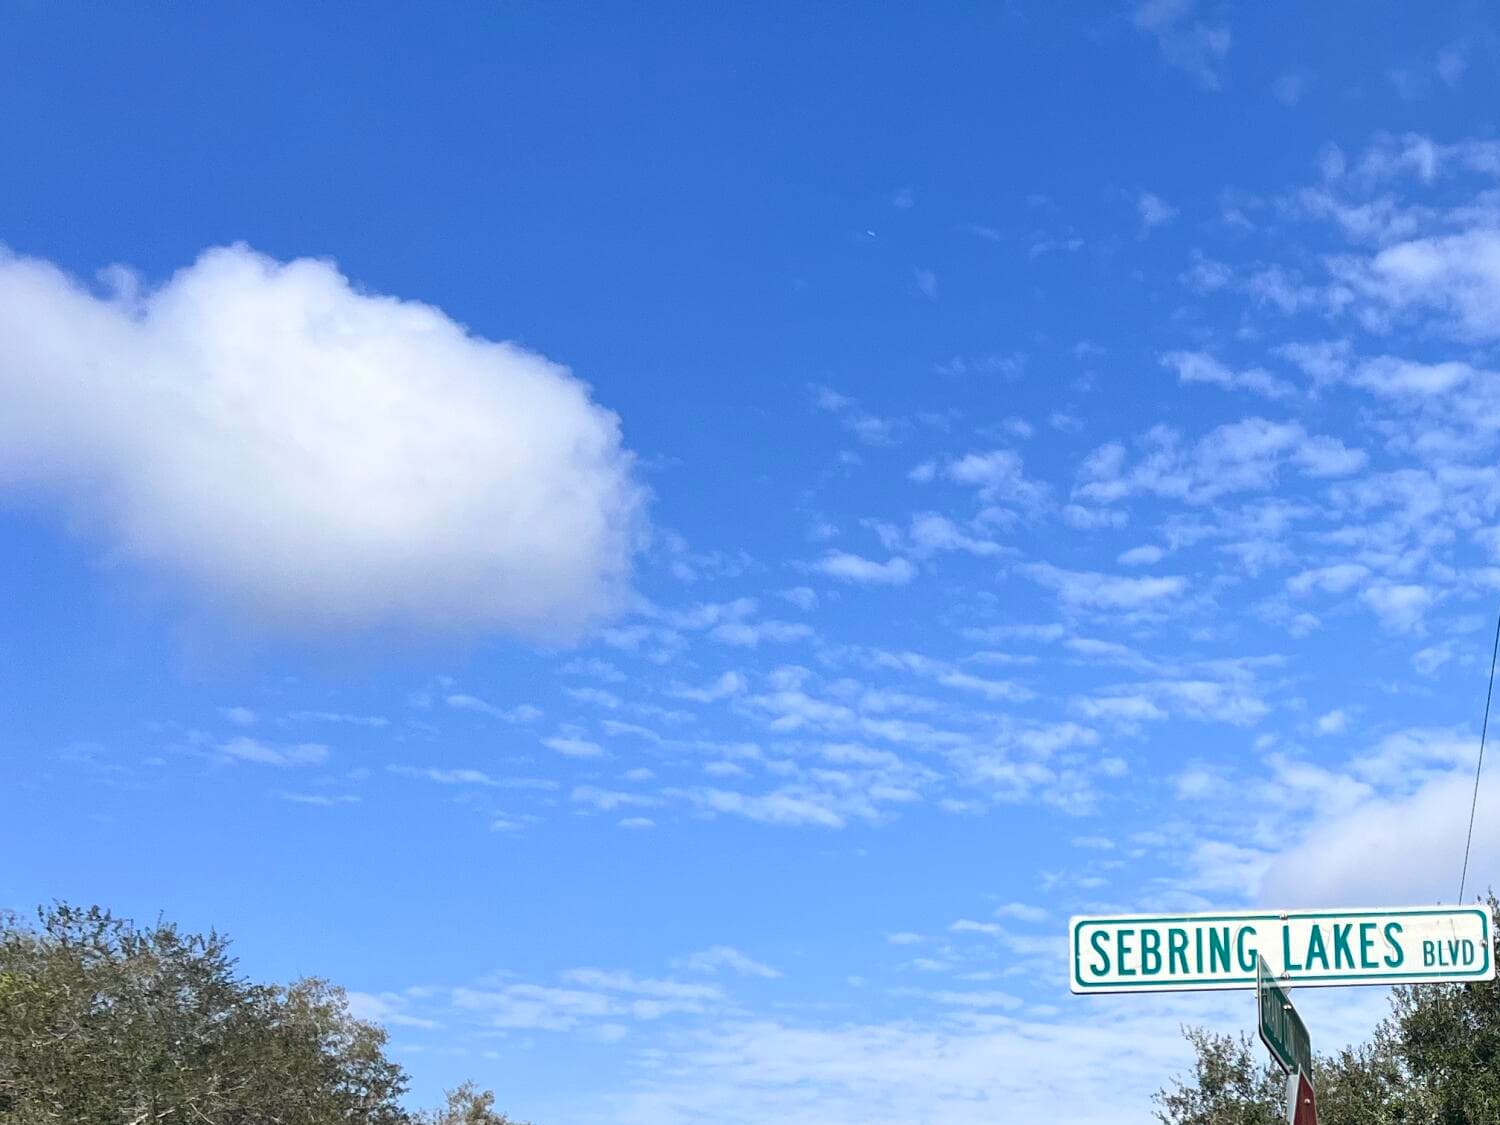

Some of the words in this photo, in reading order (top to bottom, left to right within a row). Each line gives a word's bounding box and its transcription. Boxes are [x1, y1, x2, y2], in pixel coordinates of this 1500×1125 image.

[1090, 926, 1258, 976] SEBRING
[1282, 922, 1404, 971] LAKES
[1423, 940, 1475, 967] BLVD
